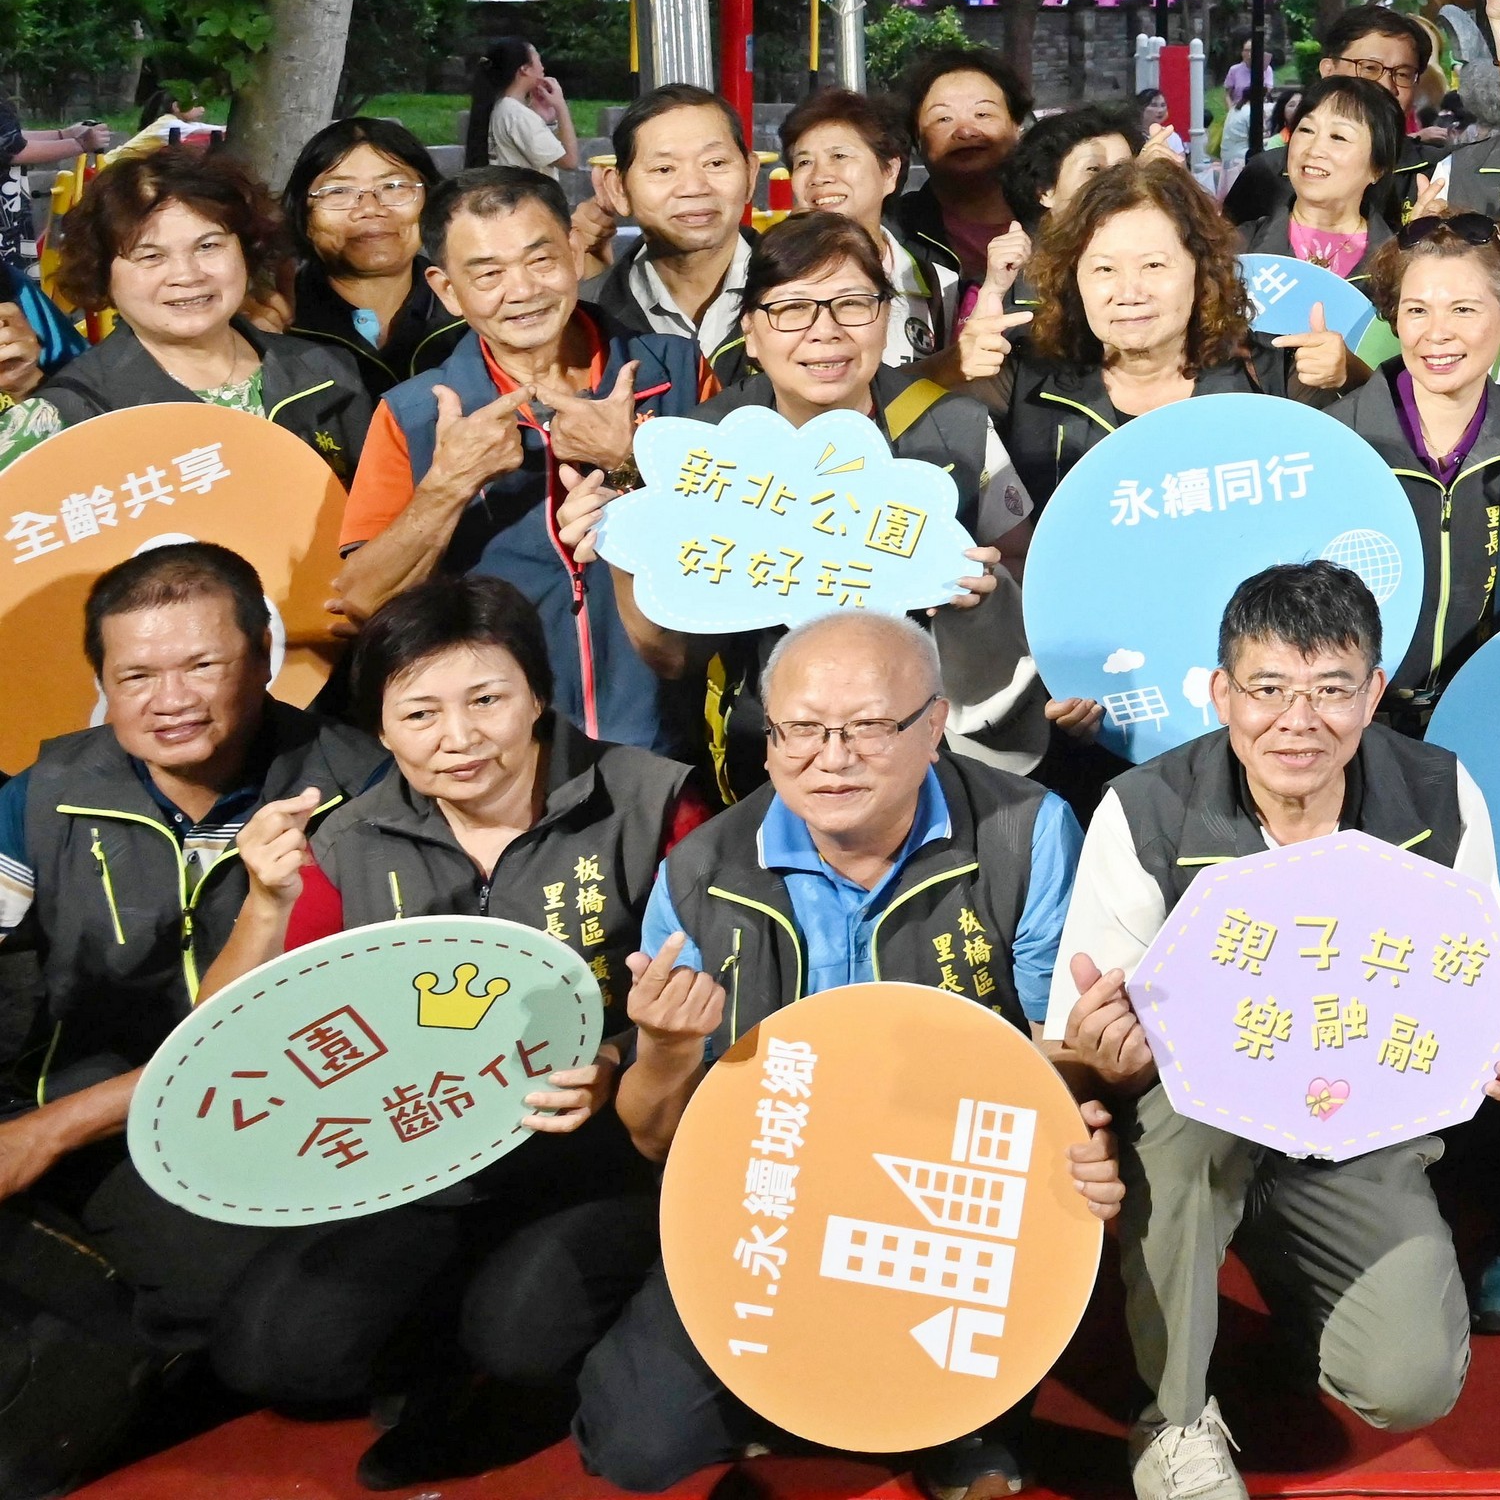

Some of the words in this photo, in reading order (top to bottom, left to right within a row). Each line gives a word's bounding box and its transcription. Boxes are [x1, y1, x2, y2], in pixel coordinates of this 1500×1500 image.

[3, 442, 232, 565] 全齡共享
[674, 447, 928, 559] 新北公園
[1110, 451, 1315, 528] 永續同行
[1484, 505, 1500, 556] 里長
[676, 534, 873, 607] 好好玩
[542, 881, 570, 941] 里長
[573, 854, 607, 947] 板橋區
[932, 932, 965, 993] 里長
[958, 907, 996, 998] 板橋區
[1210, 907, 1492, 987] 親子共遊
[196, 1004, 389, 1132] 公園
[1231, 994, 1440, 1076] 樂融融
[296, 1039, 554, 1170] 全齡化
